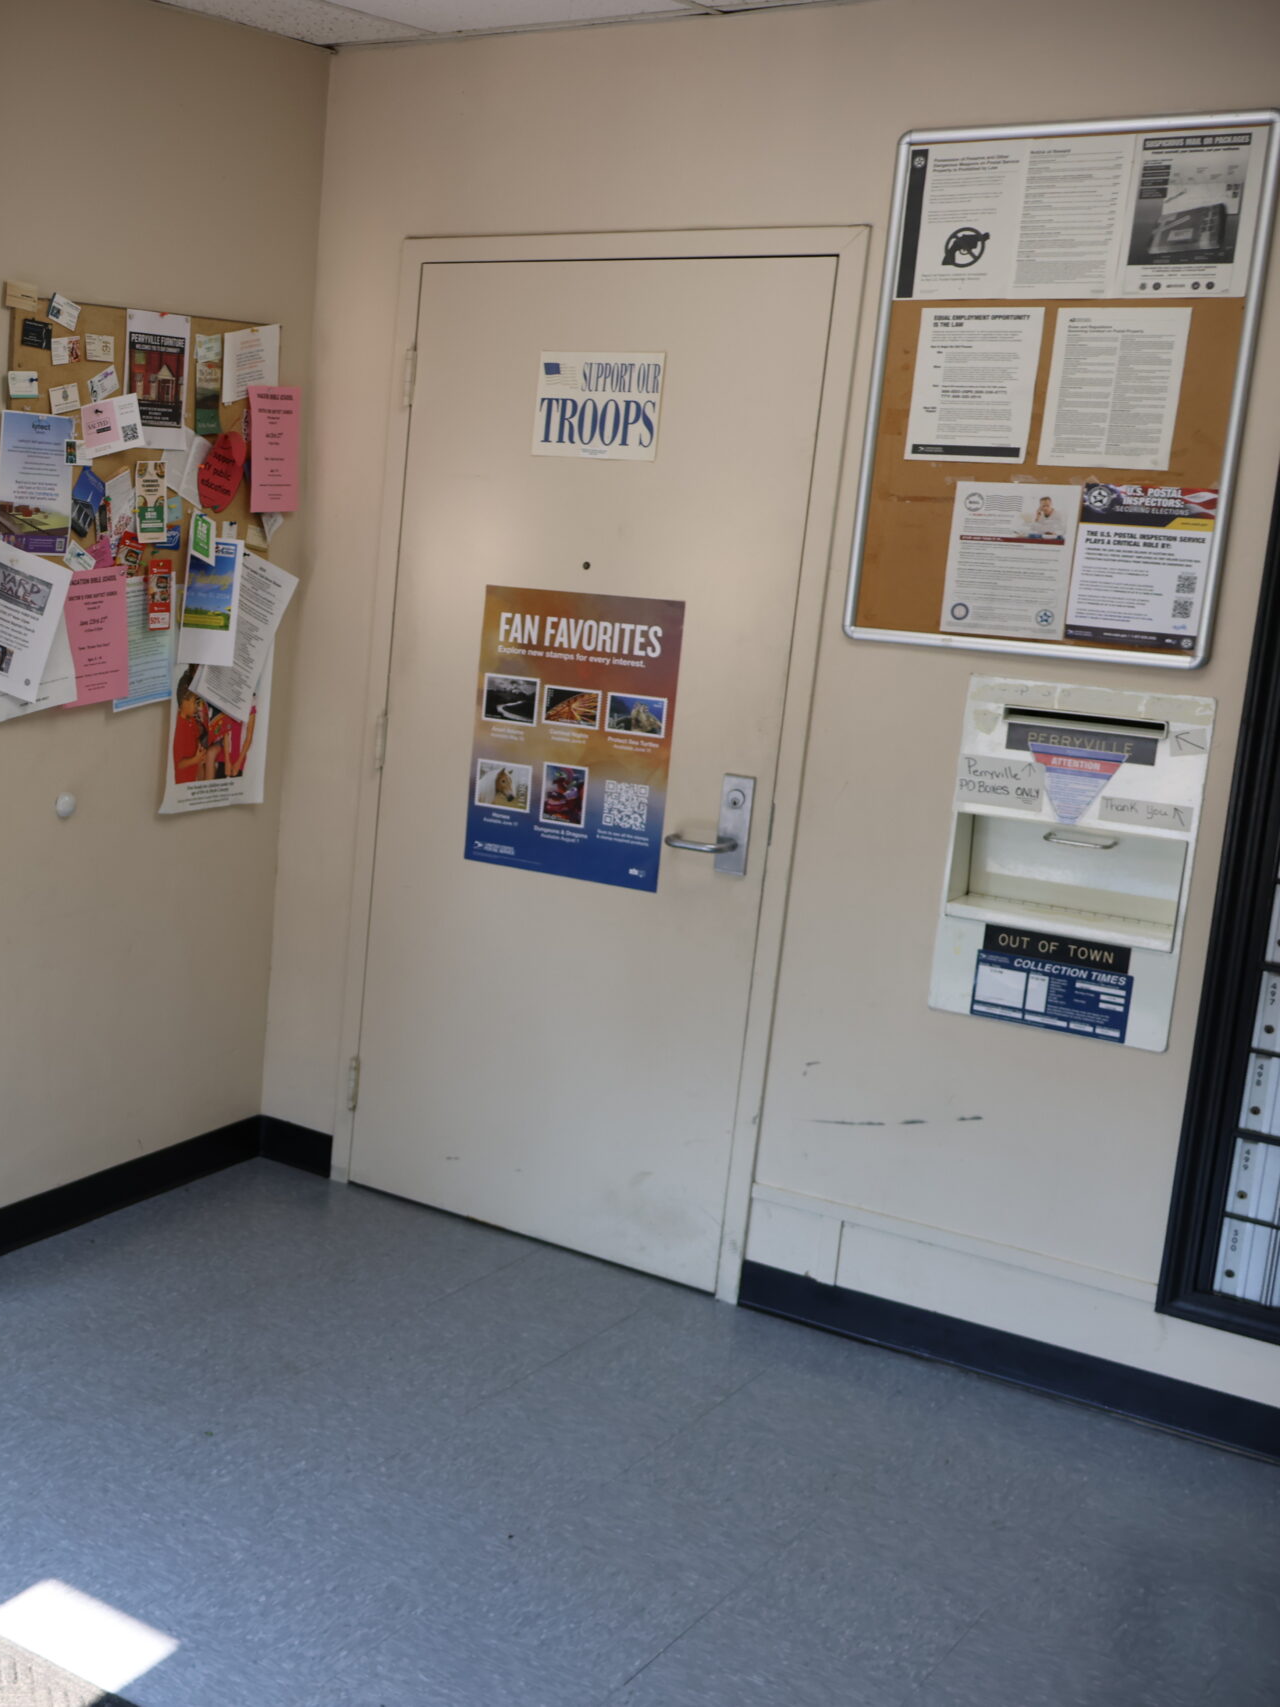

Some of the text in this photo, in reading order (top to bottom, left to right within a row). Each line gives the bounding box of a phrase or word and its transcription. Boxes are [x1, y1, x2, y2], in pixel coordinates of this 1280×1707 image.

[581, 362, 661, 394] SUPPORT OUR
[539, 397, 656, 448] TROOPS
[1122, 497, 1184, 508] INSPECTORS:
[1147, 487, 1183, 498] POSTAL
[1085, 537, 1105, 545] PLAYS
[1113, 532, 1137, 540] POSTAL
[1139, 534, 1177, 542] INSPECTION
[1179, 536, 1206, 544] SERVICE
[1, 570, 41, 594] YARD
[90, 574, 117, 584] BIBLE SCHOOL
[0, 582, 33, 601] SALE
[498, 612, 663, 658] FAN FAVORITES
[497, 645, 646, 668] Explore new stamps for every interest.
[1027, 732, 1134, 756] PERRYVILLE
[964, 757, 1021, 781] Perryville
[1051, 757, 1101, 771] ATTENTION
[959, 779, 976, 791] PO
[1015, 787, 1040, 799] ONLY
[1104, 800, 1169, 820] Thank you
[998, 933, 1115, 964] OUT OF TOWN
[1014, 958, 1089, 979] COLLECTION
[1091, 971, 1127, 986] TIMES
[1230, 1229, 1239, 1252] 500
